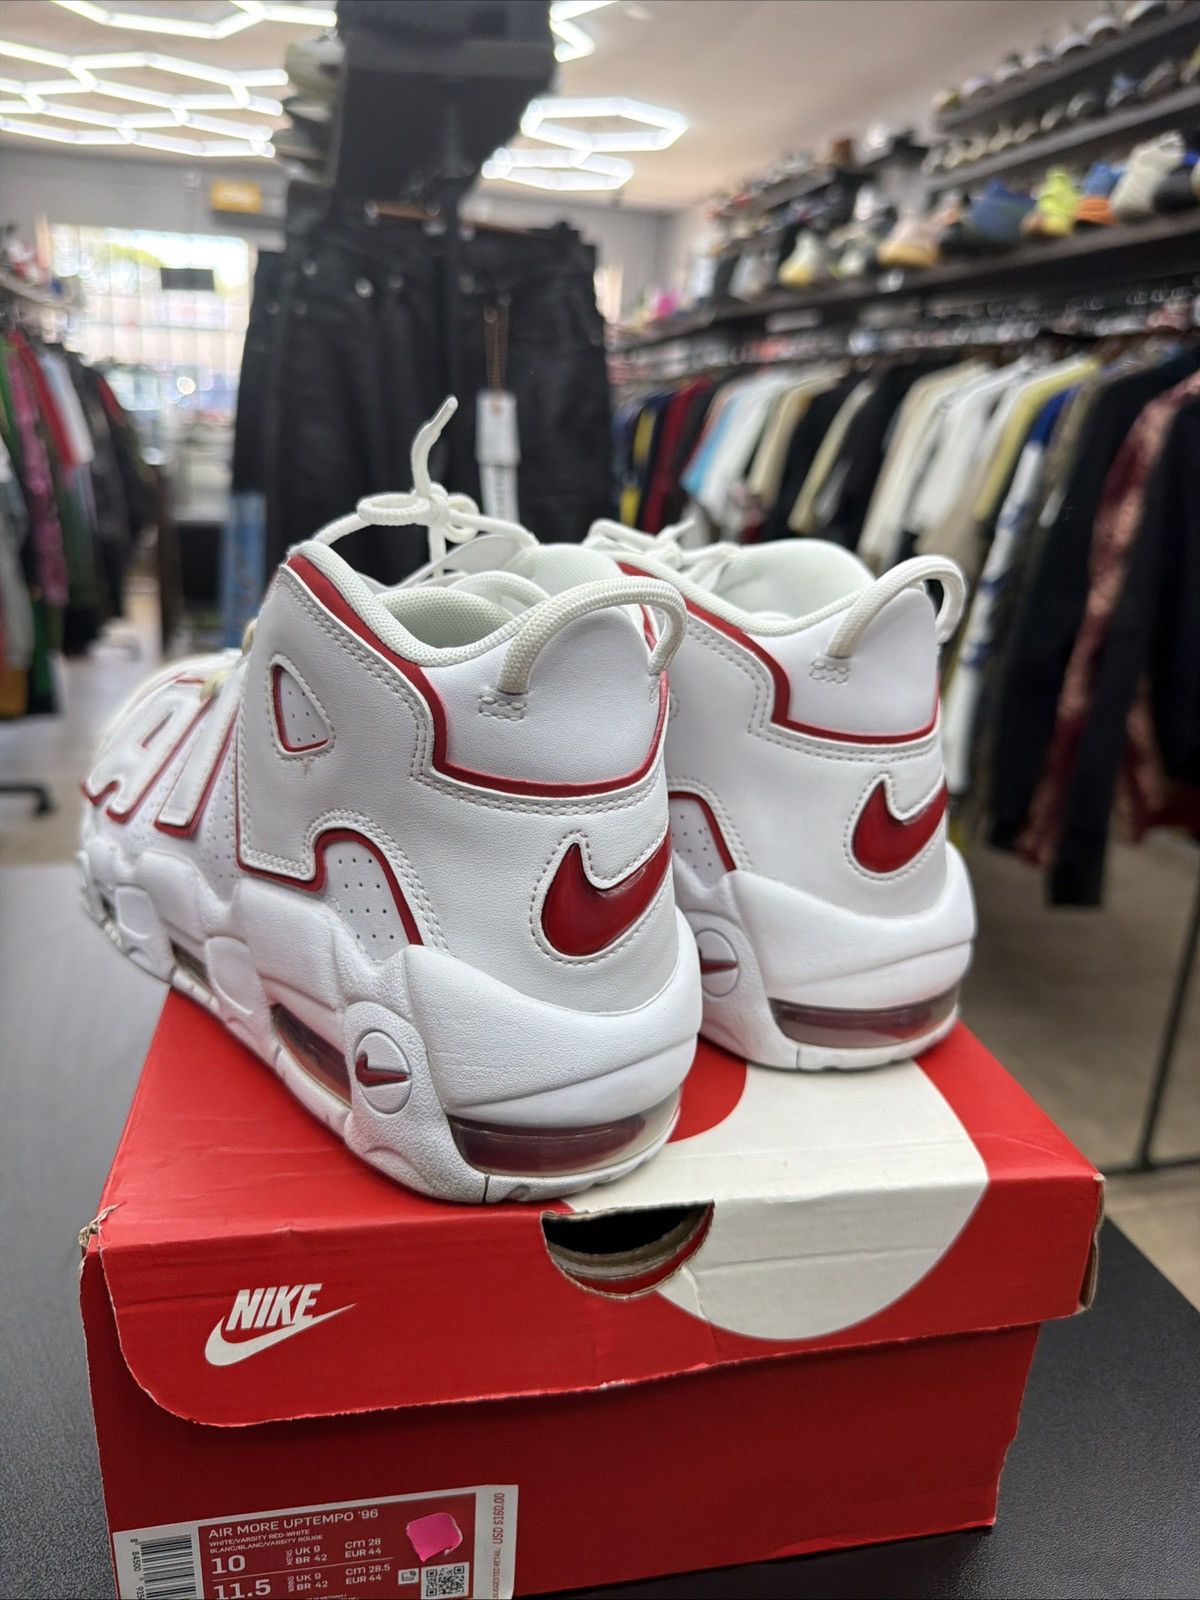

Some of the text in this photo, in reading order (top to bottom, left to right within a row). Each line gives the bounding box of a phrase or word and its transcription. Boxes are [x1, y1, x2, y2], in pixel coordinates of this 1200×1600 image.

[225, 1283, 323, 1331] NIKE
[493, 1492, 505, 1525] $160.00
[208, 1508, 379, 1539] AIR MORE UPTEMPO '96
[209, 1529, 310, 1547] WHITE/VARSITY RED-WHITE
[368, 1538, 382, 1546] 28
[492, 1527, 504, 1545] USD
[209, 1534, 324, 1554] BLANC/BLANC/VARSITY ROUGE
[295, 1545, 321, 1555] UK 9
[295, 1553, 328, 1565] BR 42
[345, 1547, 382, 1558] EUR 44
[211, 1555, 246, 1575] 10
[368, 1564, 391, 1574] 28.5
[296, 1572, 322, 1582] UK 9
[345, 1574, 382, 1585] EUR 44
[213, 1579, 272, 1600] 11.5
[296, 1580, 329, 1591] BR 42
